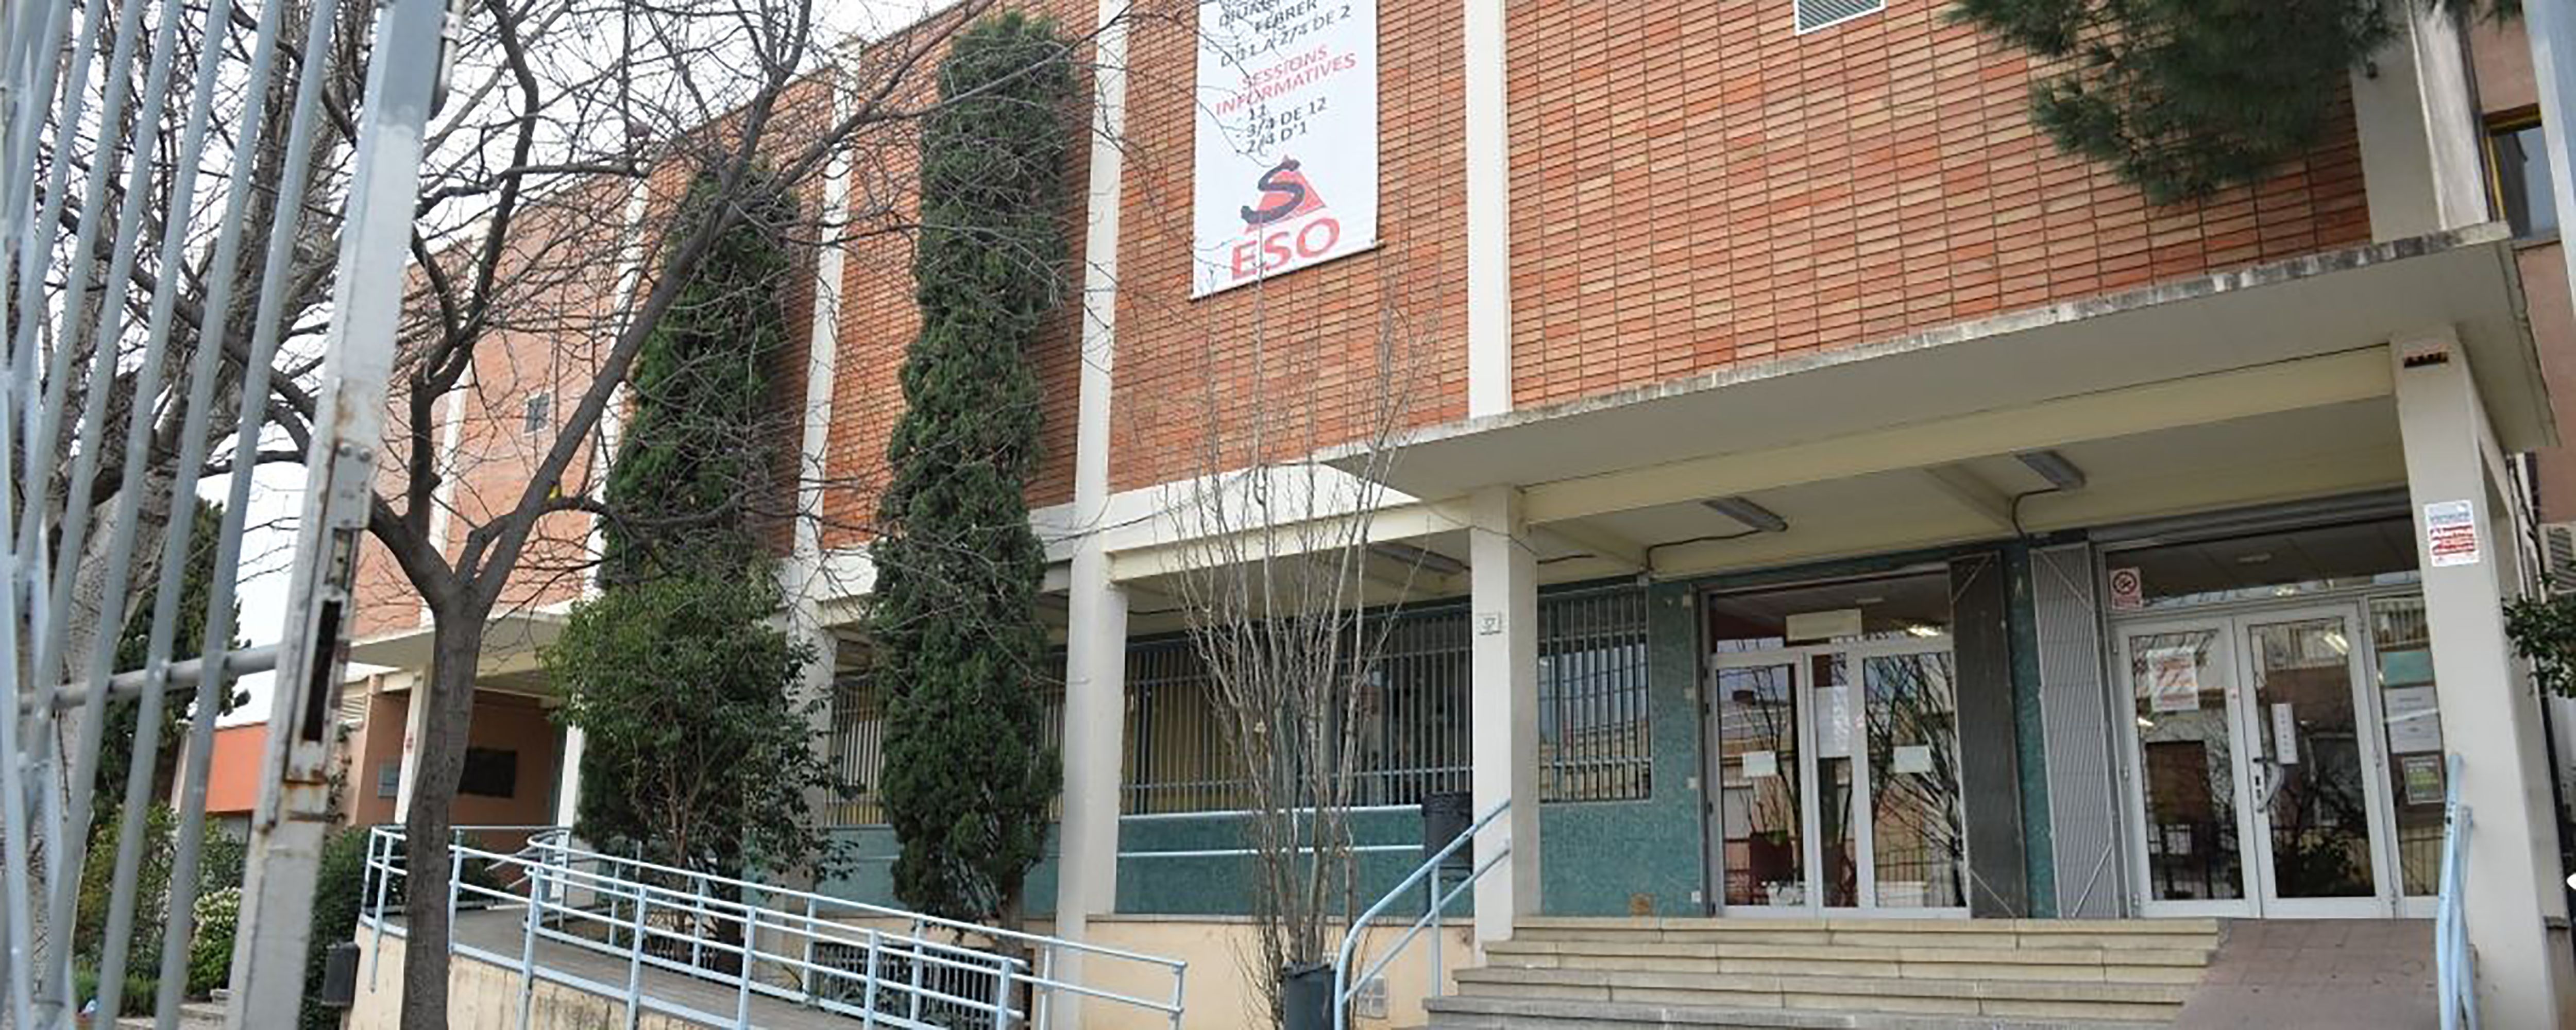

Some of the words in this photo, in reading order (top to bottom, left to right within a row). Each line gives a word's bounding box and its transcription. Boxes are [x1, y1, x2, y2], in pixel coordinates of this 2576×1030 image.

[1313, 12, 1334, 31] DE
[1340, 5, 1351, 19] 2
[1216, 52, 1356, 115] INFORMATIVES
[1242, 44, 1327, 91] SESSIONS
[1281, 107, 1302, 126] DE
[1310, 96, 1328, 114] 12
[1281, 121, 1307, 142] D'1
[1231, 217, 1340, 280] ESO
